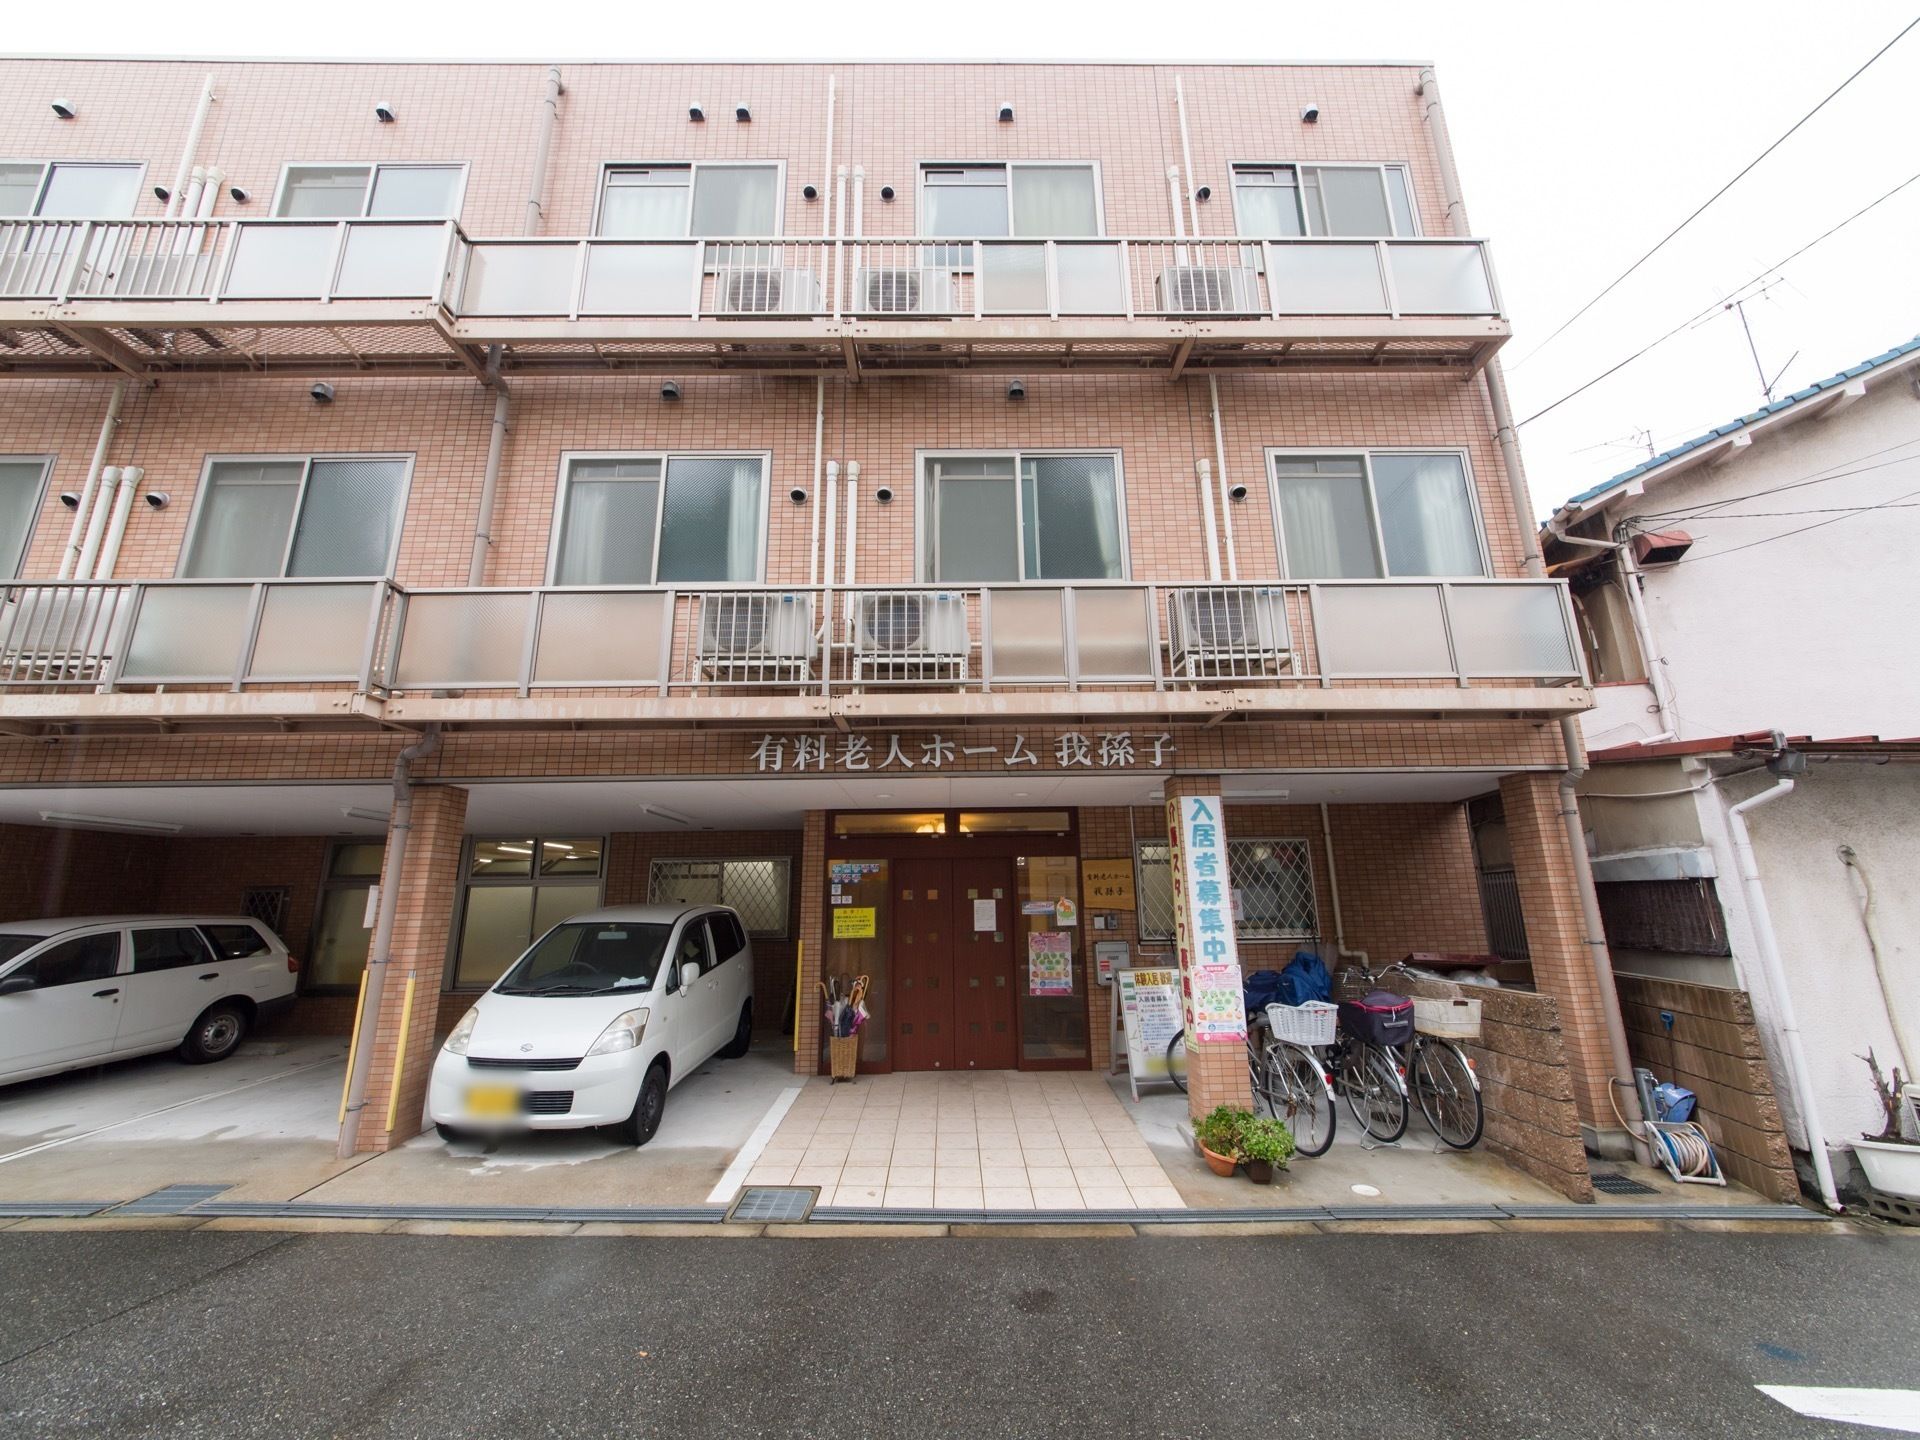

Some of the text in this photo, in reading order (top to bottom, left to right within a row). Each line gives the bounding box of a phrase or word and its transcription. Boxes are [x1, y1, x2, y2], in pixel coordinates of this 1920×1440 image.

[749, 731, 1177, 771] 有料老人ホーム 我孫子
[1168, 801, 1194, 1030] 介護スタッフ募集中
[1190, 798, 1227, 963] 入居者募集中
